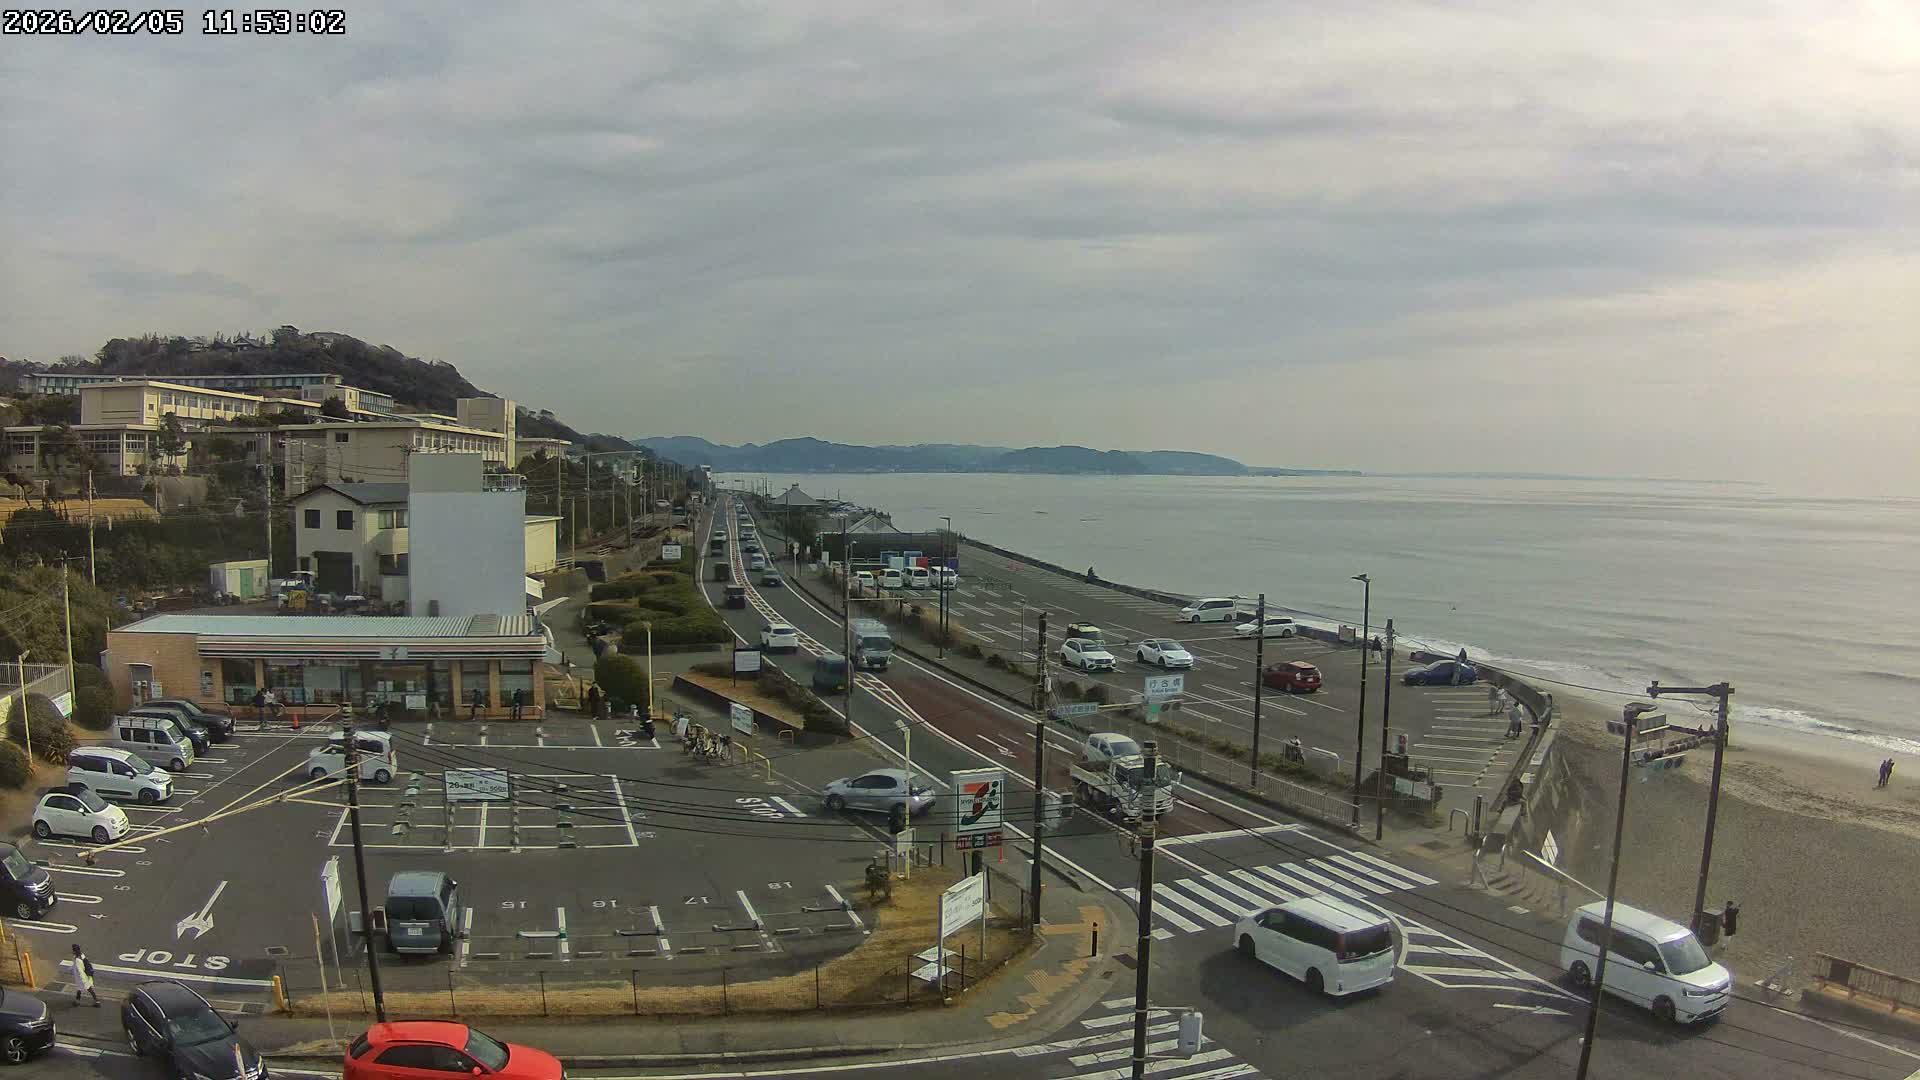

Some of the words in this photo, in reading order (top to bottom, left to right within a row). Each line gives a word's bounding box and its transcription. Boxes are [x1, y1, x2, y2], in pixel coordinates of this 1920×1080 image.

[735, 797, 784, 819] STOP
[767, 880, 793, 890] 18
[501, 900, 527, 909] 15
[592, 899, 618, 908] 16
[684, 896, 710, 905] 17
[118, 949, 231, 970] STOP
